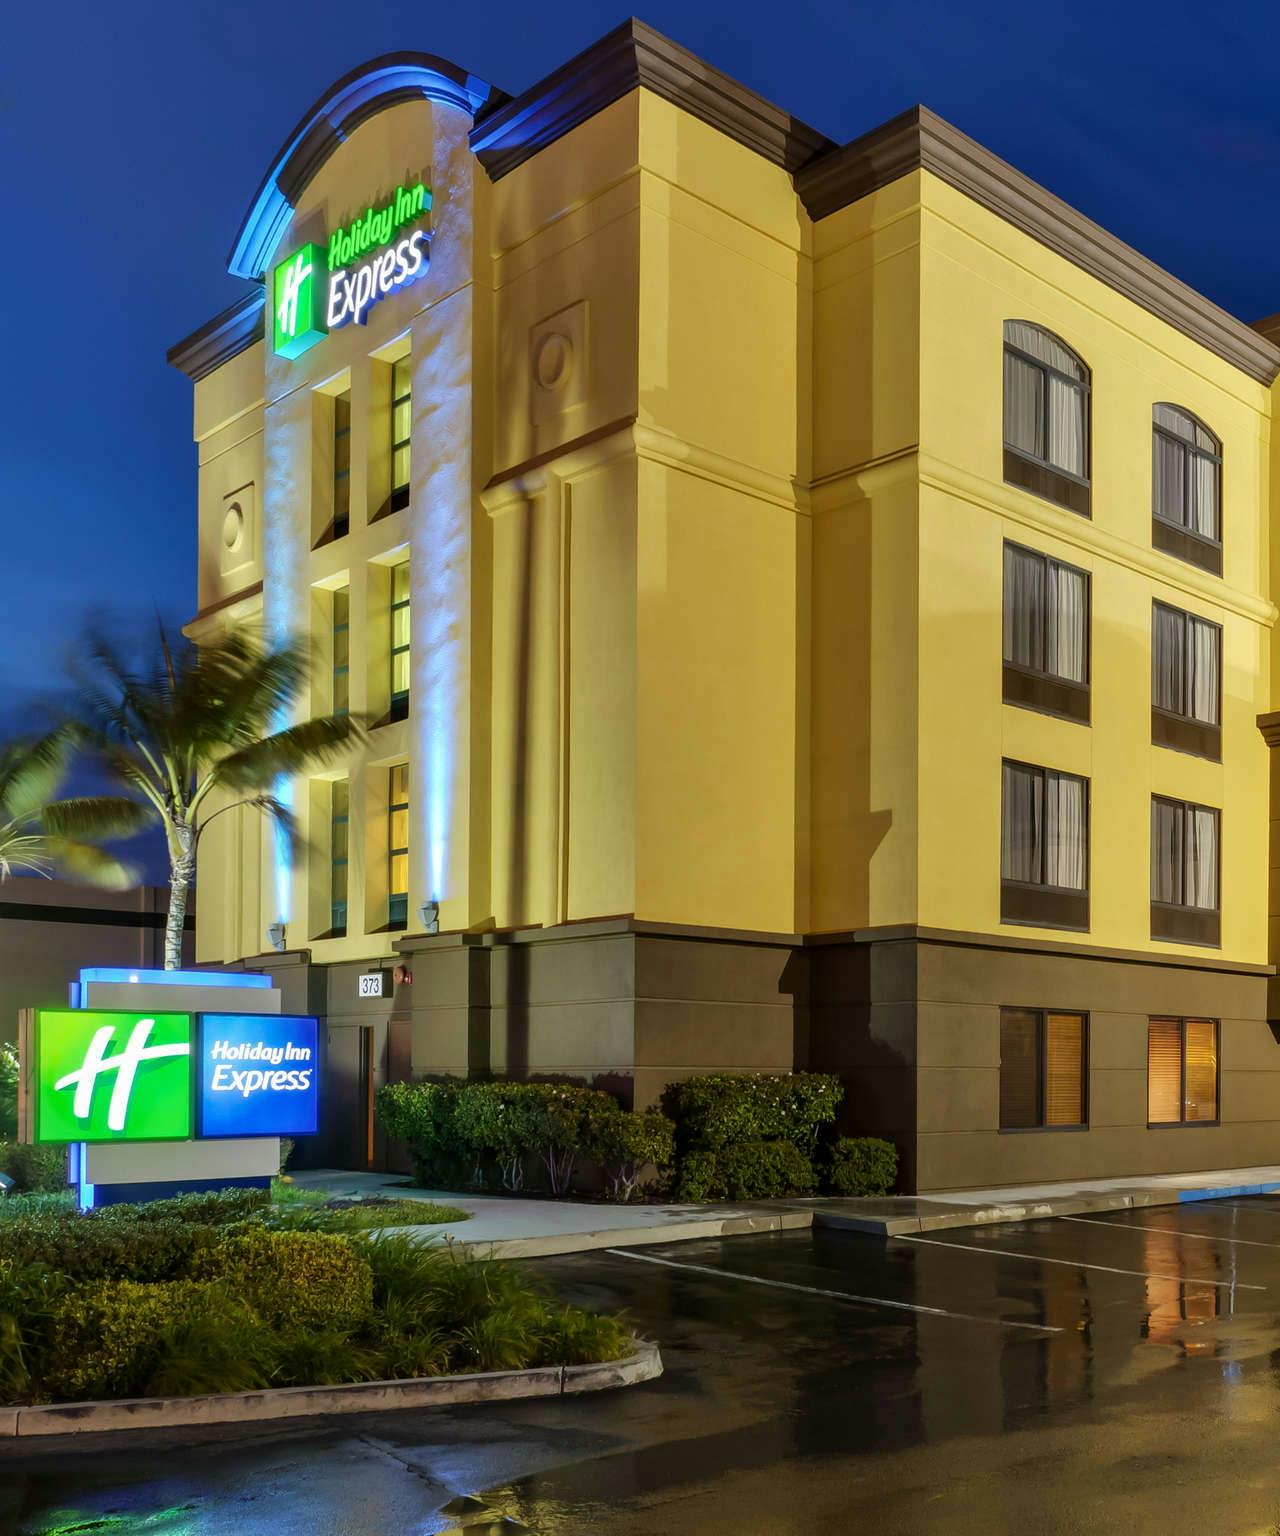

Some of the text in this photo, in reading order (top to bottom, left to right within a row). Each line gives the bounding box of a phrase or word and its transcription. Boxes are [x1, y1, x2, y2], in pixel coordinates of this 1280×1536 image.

[328, 184, 425, 271] Holiday Inn
[327, 230, 424, 327] Express
[362, 977, 380, 994] 373
[211, 1040, 311, 1065] Holiday Inn
[211, 1064, 311, 1098] Express
